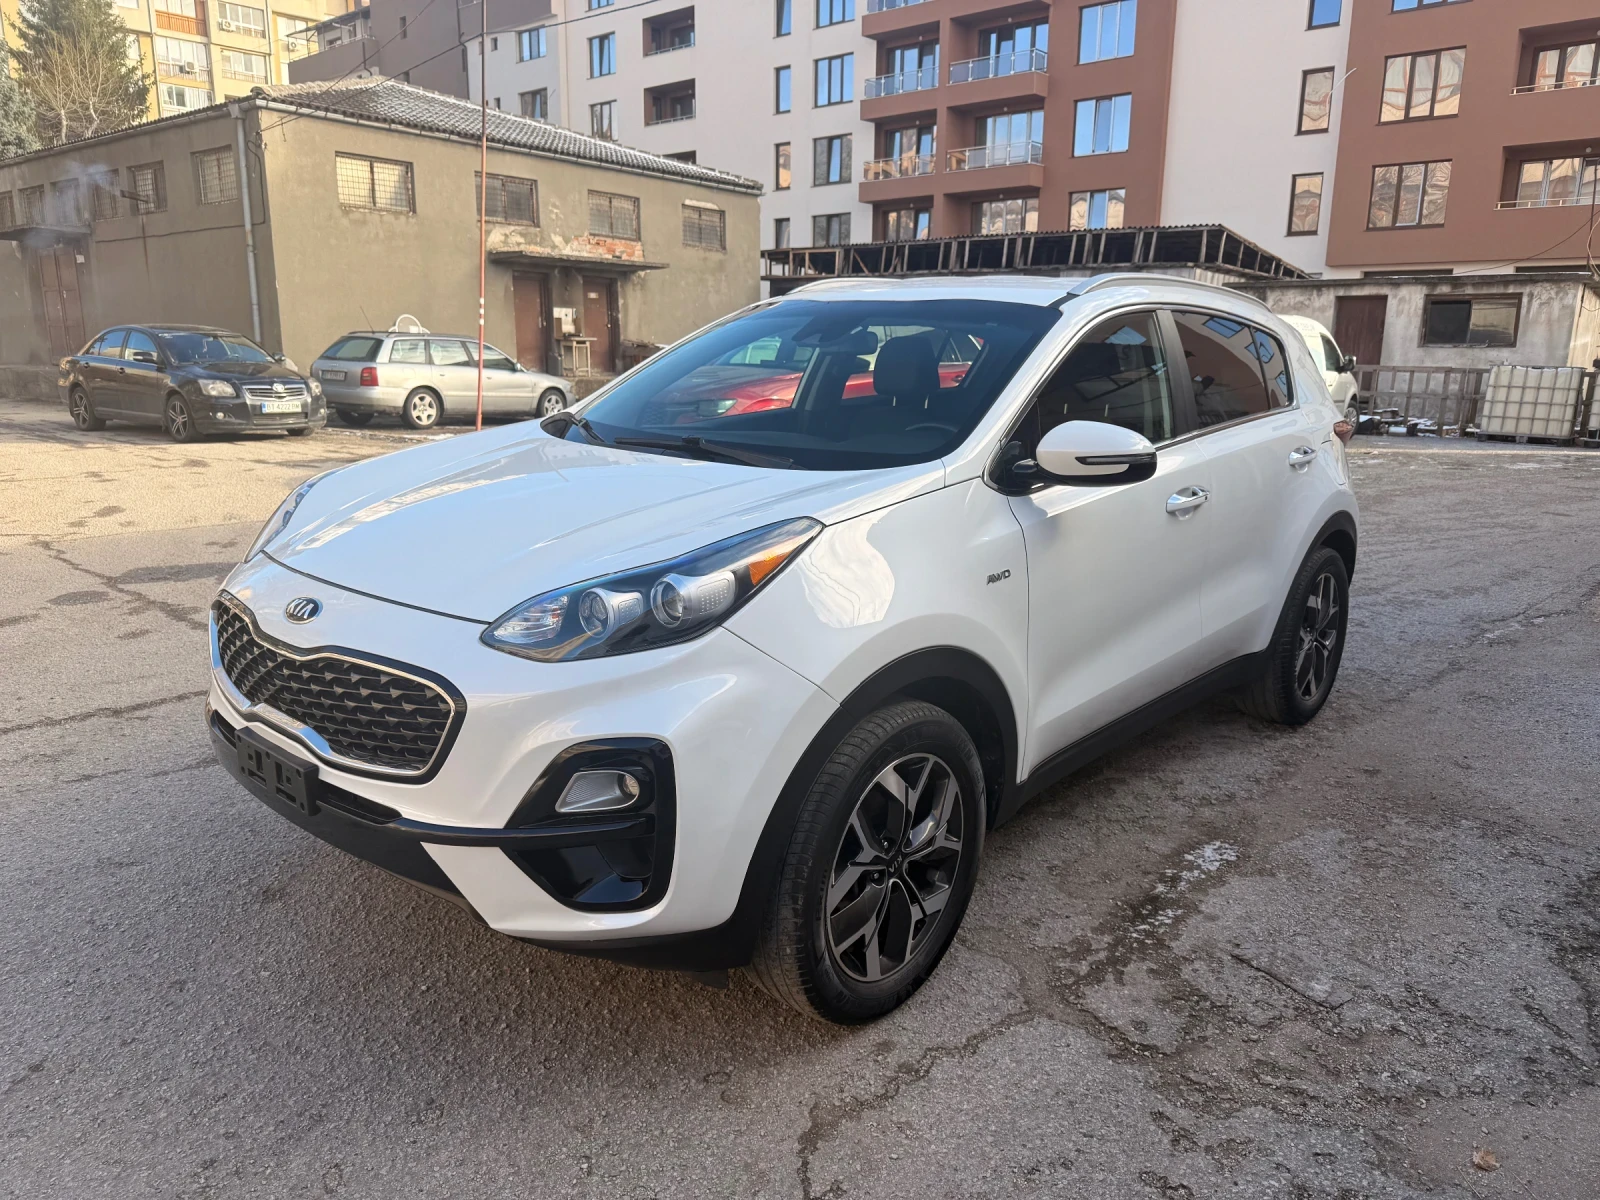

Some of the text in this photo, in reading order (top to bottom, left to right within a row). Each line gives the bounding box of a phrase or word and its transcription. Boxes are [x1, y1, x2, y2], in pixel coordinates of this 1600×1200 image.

[986, 569, 1011, 585] AWD
[286, 598, 315, 620] KIA
[888, 854, 903, 873] KIA
